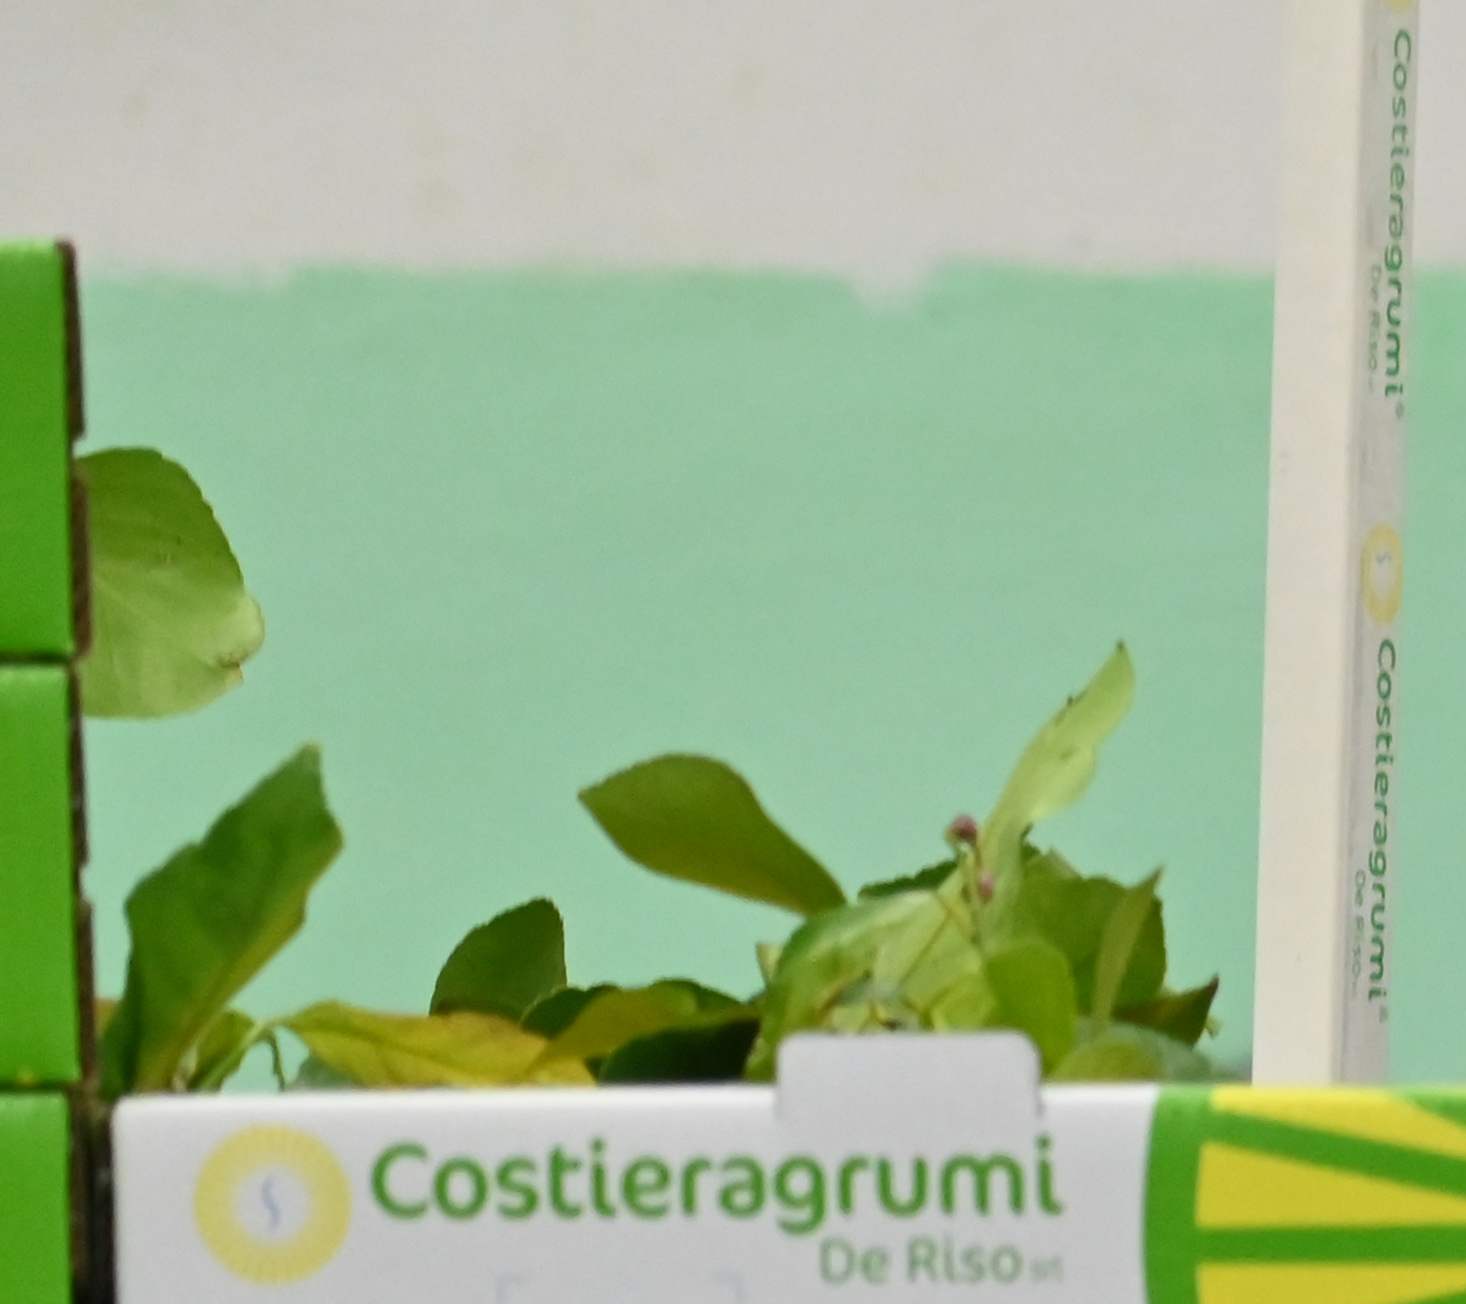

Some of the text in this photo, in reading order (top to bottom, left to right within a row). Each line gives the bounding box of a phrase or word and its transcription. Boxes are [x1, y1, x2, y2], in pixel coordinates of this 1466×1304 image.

[371, 1135, 1062, 1237] Costieragrumi
[818, 1236, 889, 1285] De
[906, 1233, 1024, 1285] Riso
